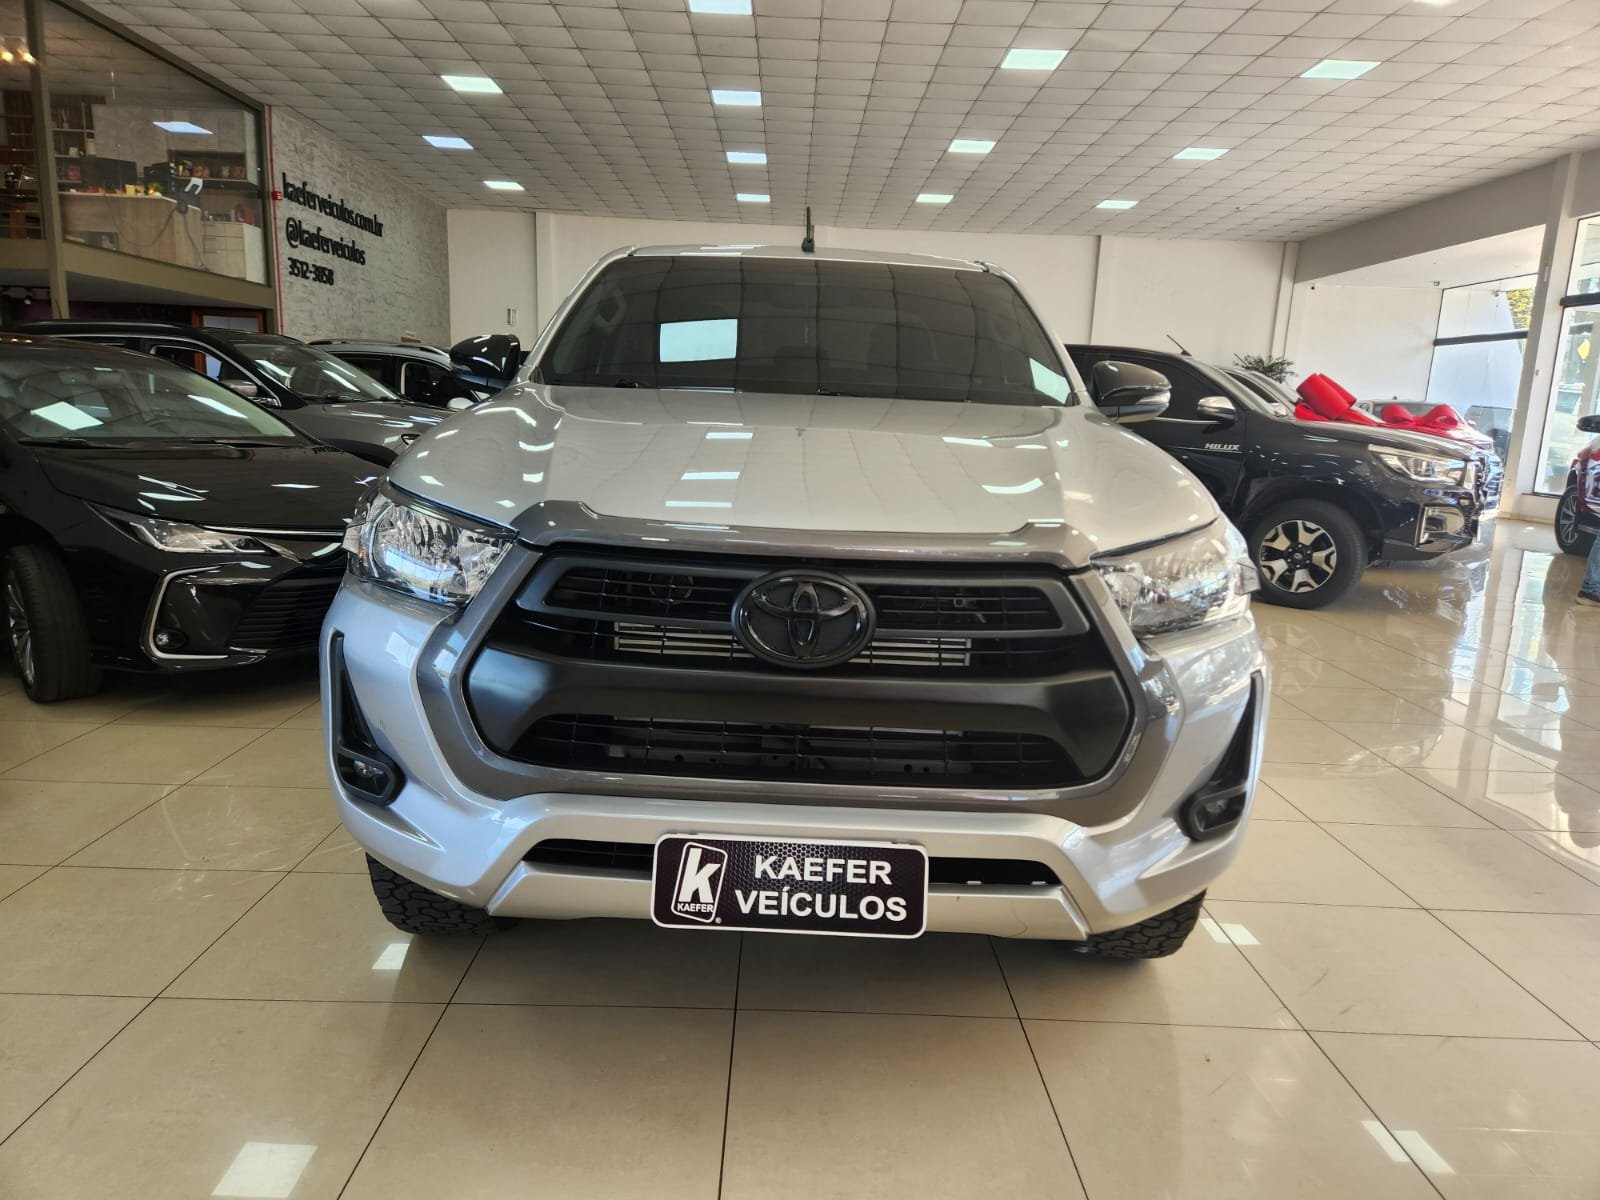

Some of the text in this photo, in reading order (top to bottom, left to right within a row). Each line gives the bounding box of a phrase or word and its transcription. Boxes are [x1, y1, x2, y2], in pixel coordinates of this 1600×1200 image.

[1204, 443, 1240, 451] HILUX
[755, 855, 892, 885] KAEFER
[677, 902, 714, 913] KAEFER
[735, 885, 907, 922] VEÍCULOS
